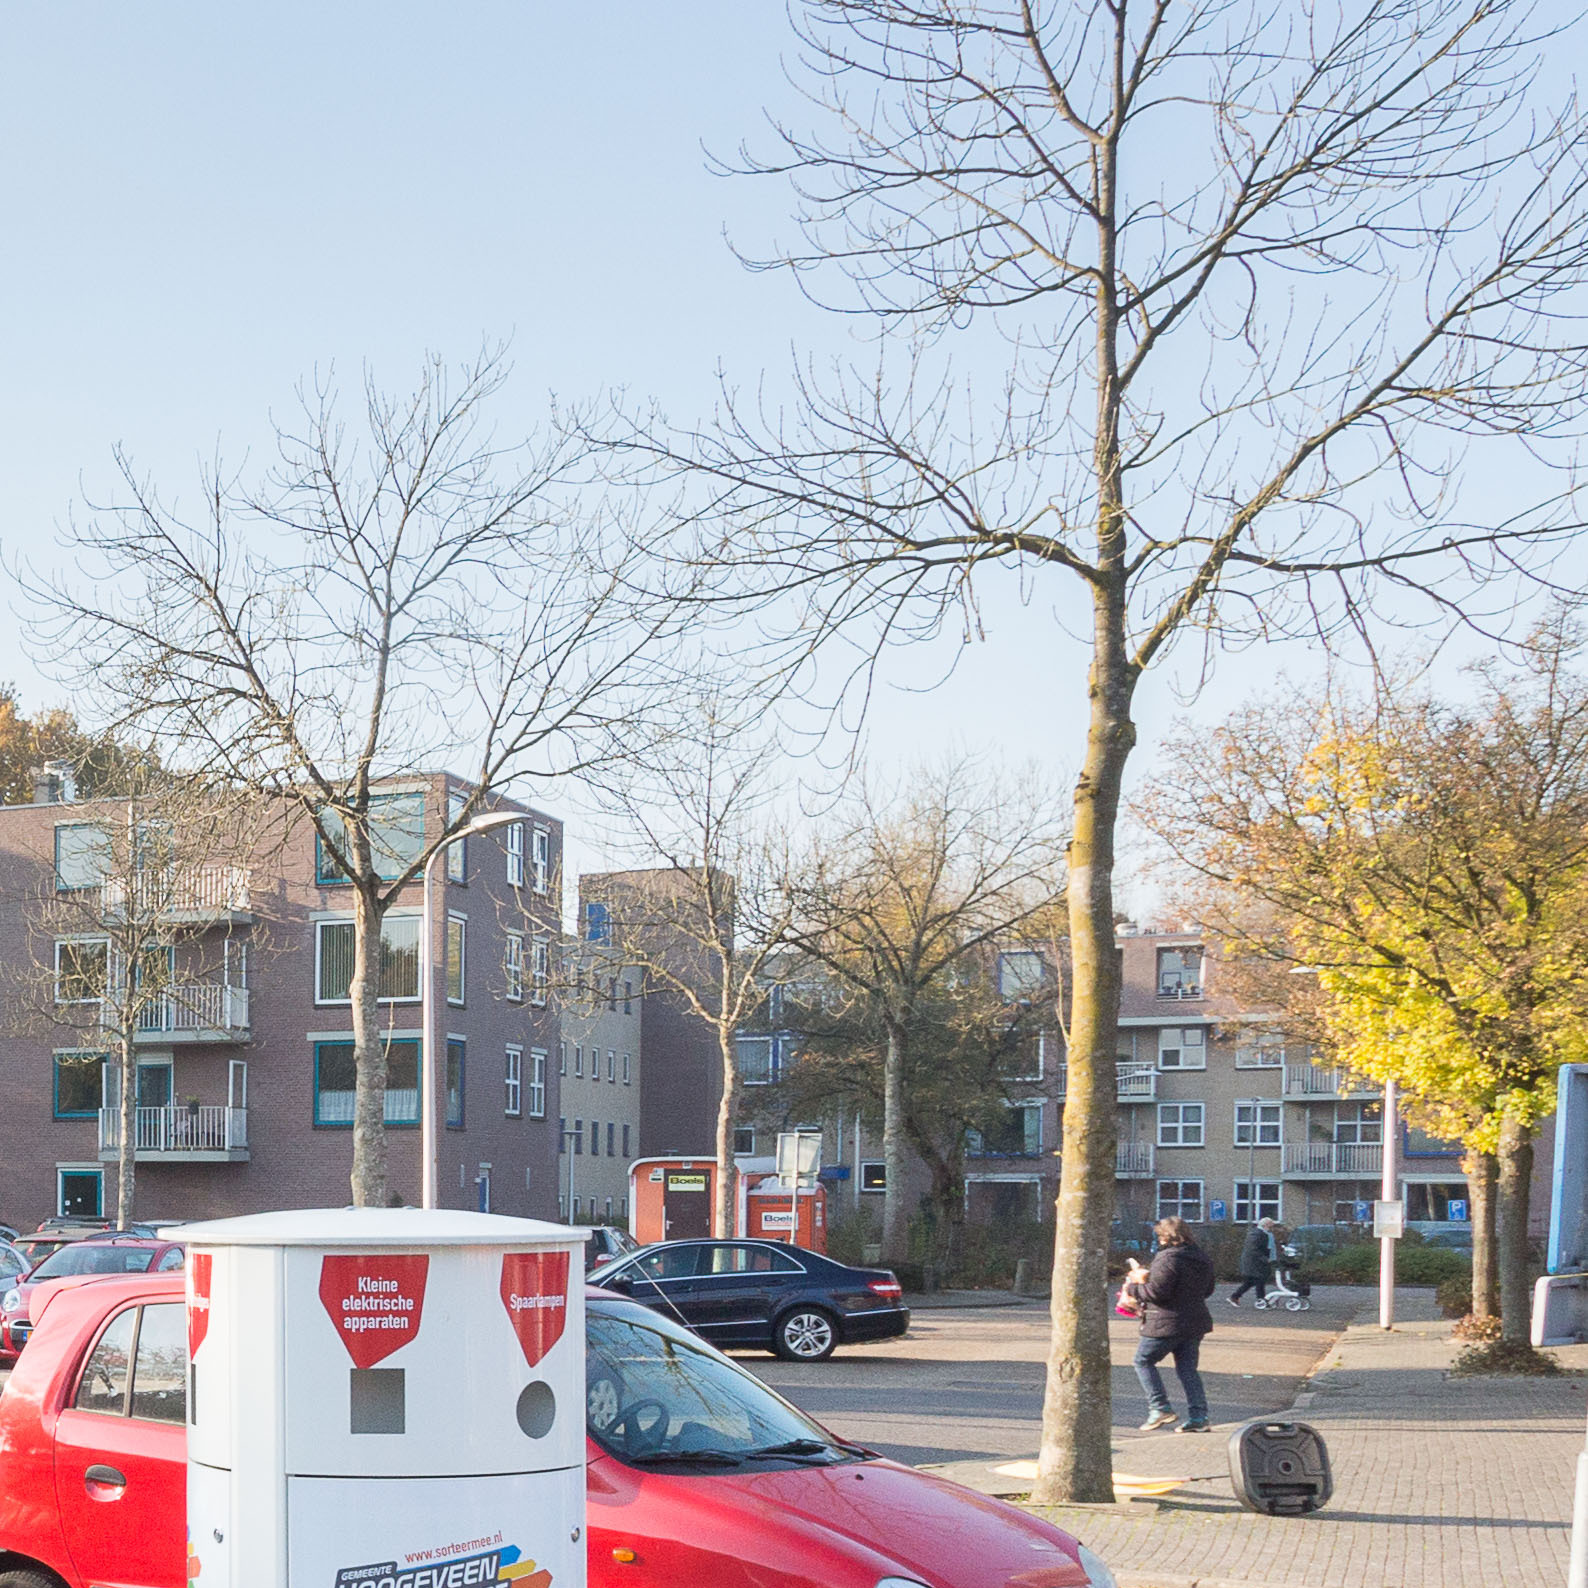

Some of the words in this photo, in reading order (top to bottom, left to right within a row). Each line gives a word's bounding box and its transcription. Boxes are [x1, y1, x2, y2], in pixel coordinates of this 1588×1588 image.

[669, 1176, 704, 1186] Boels
[1452, 1201, 1463, 1214] P
[357, 1276, 399, 1292] Kleine
[342, 1294, 414, 1311] elektrische
[509, 1293, 565, 1312] Spaarlampen
[343, 1314, 409, 1333] apparaten
[404, 1530, 503, 1563] www.sorteermee.nl
[340, 1564, 393, 1581] GEMEENTE
